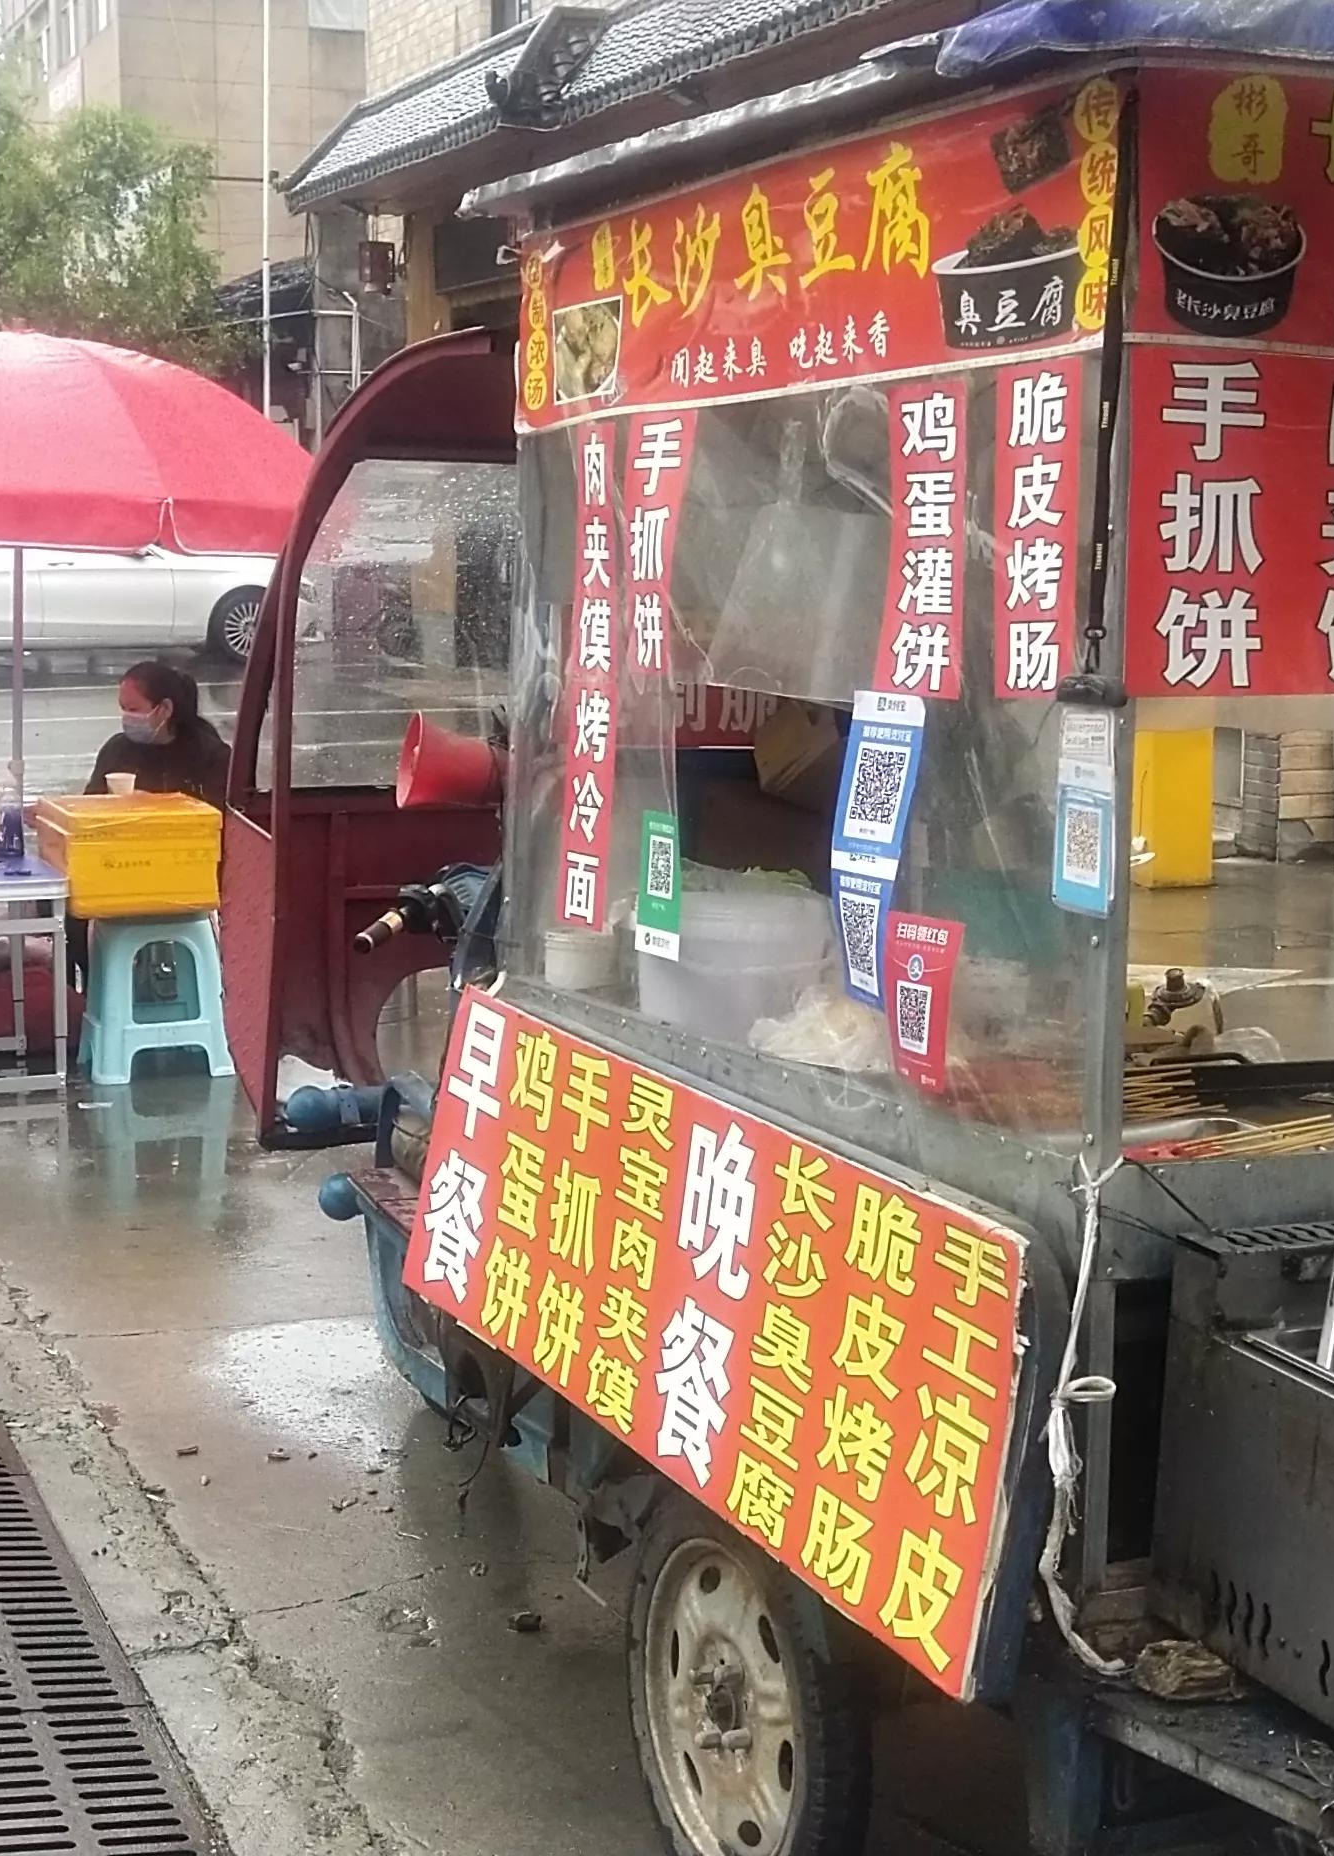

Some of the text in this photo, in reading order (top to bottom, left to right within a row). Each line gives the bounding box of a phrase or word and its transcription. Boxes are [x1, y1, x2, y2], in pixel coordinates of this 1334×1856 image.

[623, 141, 933, 327] 长沙臭豆腐
[1081, 87, 1117, 321] 传统风味
[1230, 82, 1269, 176] 彬哥
[789, 310, 890, 369] 吃起来香
[955, 275, 1064, 336] 臭豆腐
[1175, 287, 1276, 321] 老长沙臭豆腐
[563, 431, 613, 926] 肉夹馍烤冷面
[629, 416, 684, 673] 手抓饼
[890, 388, 957, 693] 鸡蛋灌饼
[1005, 369, 1069, 693] 脆皮烤肠
[1155, 361, 1267, 690] 手抓饼
[896, 921, 949, 946] 扫码领红包
[421, 999, 508, 1304] 早餐
[479, 1028, 559, 1350] 鸡蛋饼
[531, 1047, 613, 1389] 手抓饼
[585, 1071, 676, 1435] 灵宝肉夹馍
[653, 1119, 760, 1489] 晚餐
[726, 1143, 837, 1550] 长沙臭豆腐
[800, 1182, 923, 1607] 脆皮烤肠
[879, 1222, 1011, 1673] 手工凉皮
